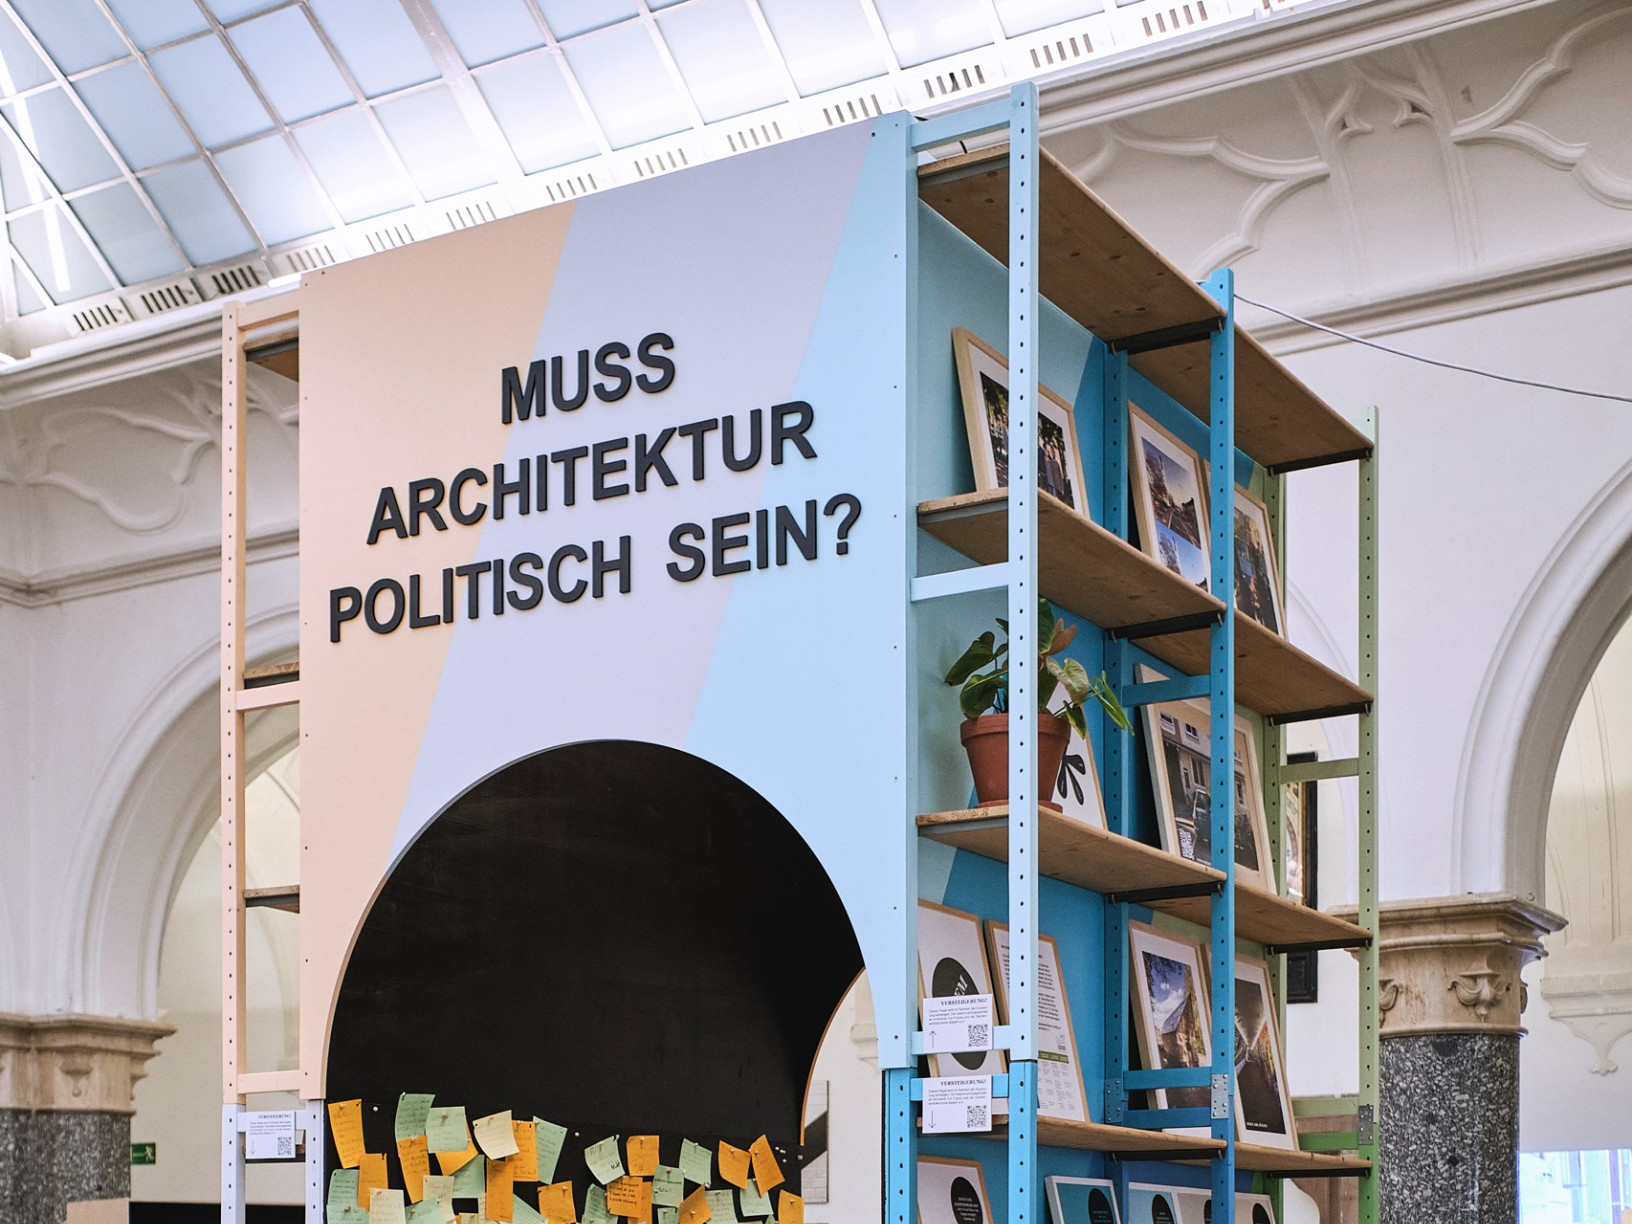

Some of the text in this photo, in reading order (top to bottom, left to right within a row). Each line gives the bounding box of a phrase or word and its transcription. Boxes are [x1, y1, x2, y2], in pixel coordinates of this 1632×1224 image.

[502, 333, 675, 424] MUSS
[367, 401, 817, 545] ARCHITEKTUR
[330, 494, 861, 643] POLITISCH SEIN?
